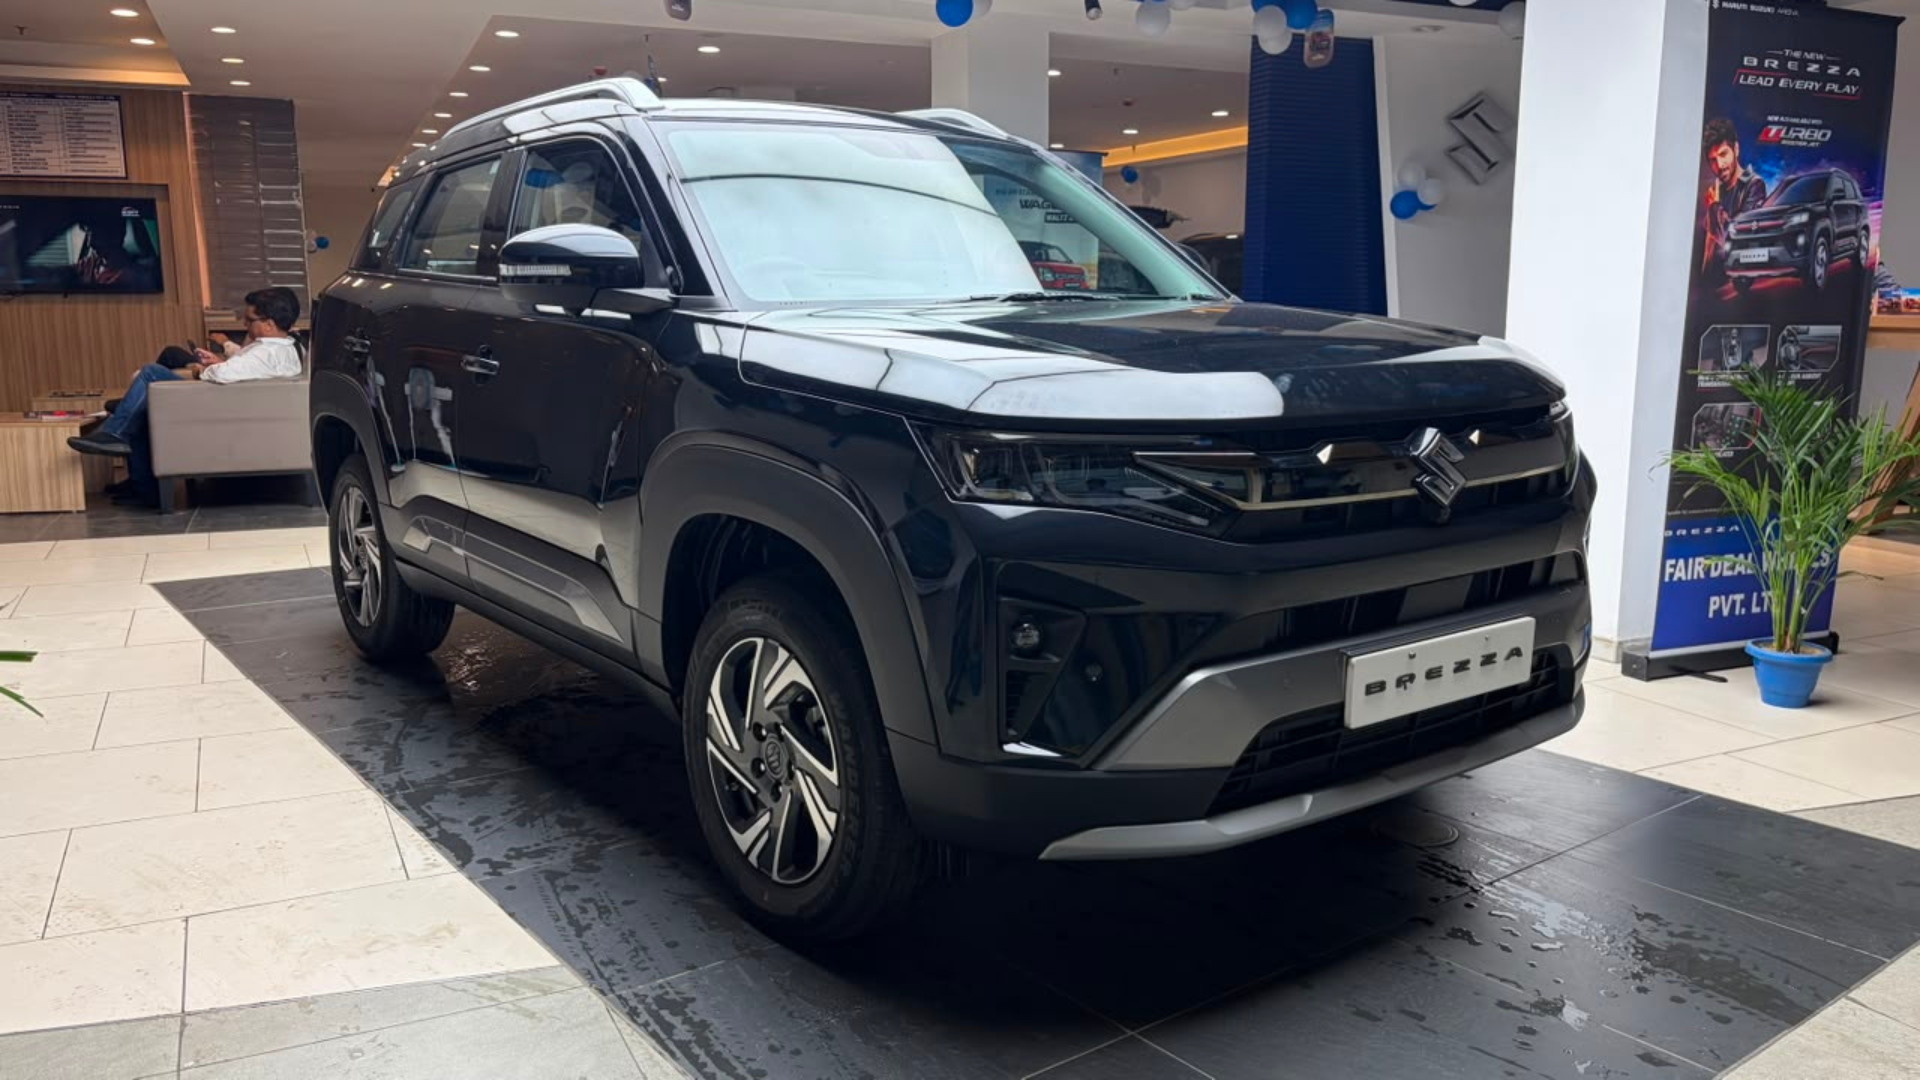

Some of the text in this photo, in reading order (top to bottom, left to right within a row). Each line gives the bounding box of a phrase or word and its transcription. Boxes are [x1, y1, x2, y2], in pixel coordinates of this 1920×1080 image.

[1749, 4, 1775, 14] SUZUKI
[1783, 49, 1825, 61] THE NEW
[1743, 56, 1861, 77] BREZZA
[1739, 74, 1859, 94] LEAD EVERY PLAY
[1767, 125, 1832, 142] TURBO
[1664, 525, 1740, 537] BREZZA
[1664, 556, 1705, 583] FAIR
[1710, 552, 1754, 578] DEAL
[1708, 593, 1746, 618] PVT.
[1364, 646, 1523, 696] BREZZA
